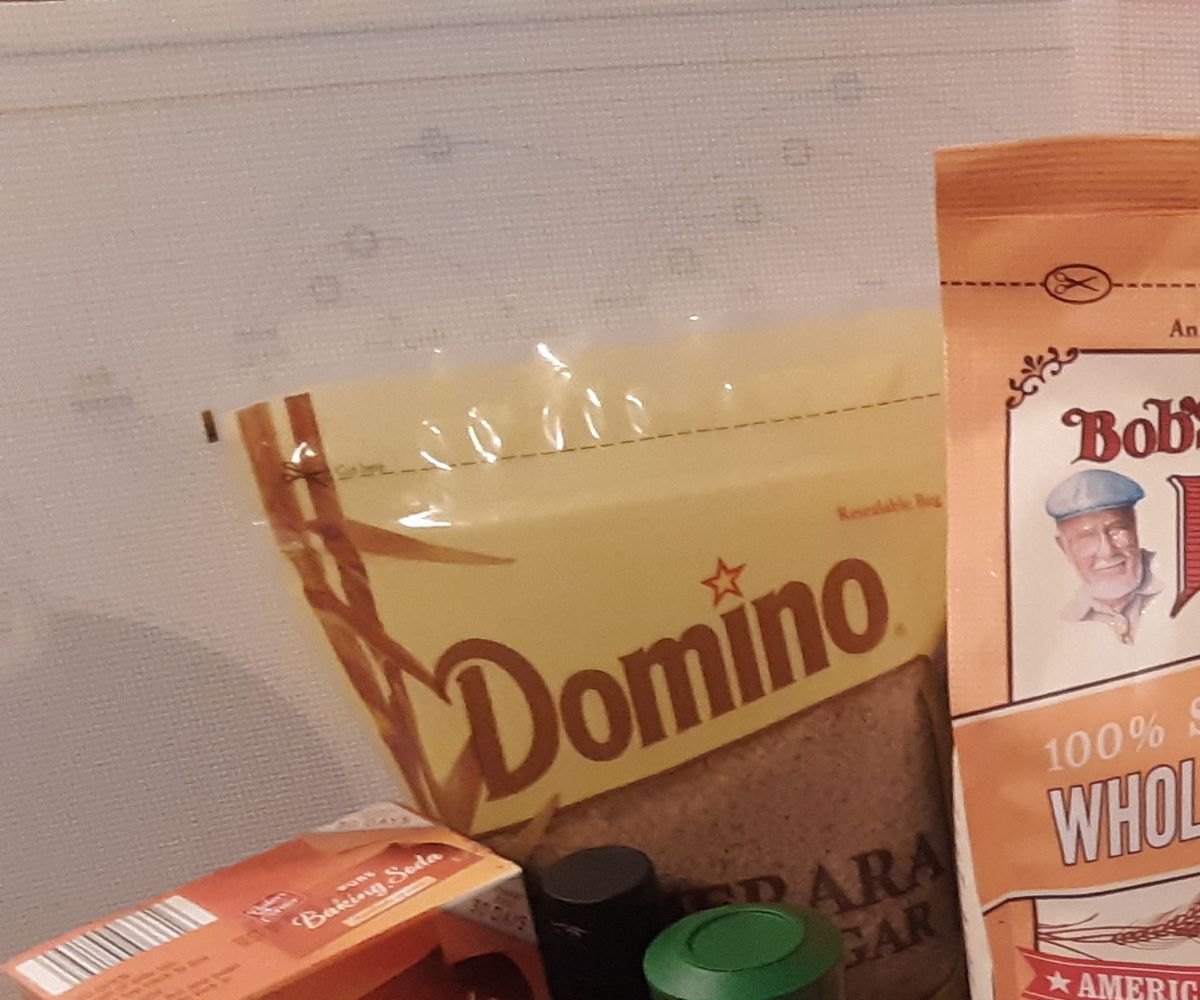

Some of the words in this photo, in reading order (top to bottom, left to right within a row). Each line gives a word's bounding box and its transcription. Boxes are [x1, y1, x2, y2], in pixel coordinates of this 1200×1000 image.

[1169, 318, 1199, 338] An
[432, 556, 889, 803] Domino
[1044, 712, 1166, 775] 100%
[291, 881, 391, 930] Baking
[385, 853, 444, 886] Soda
